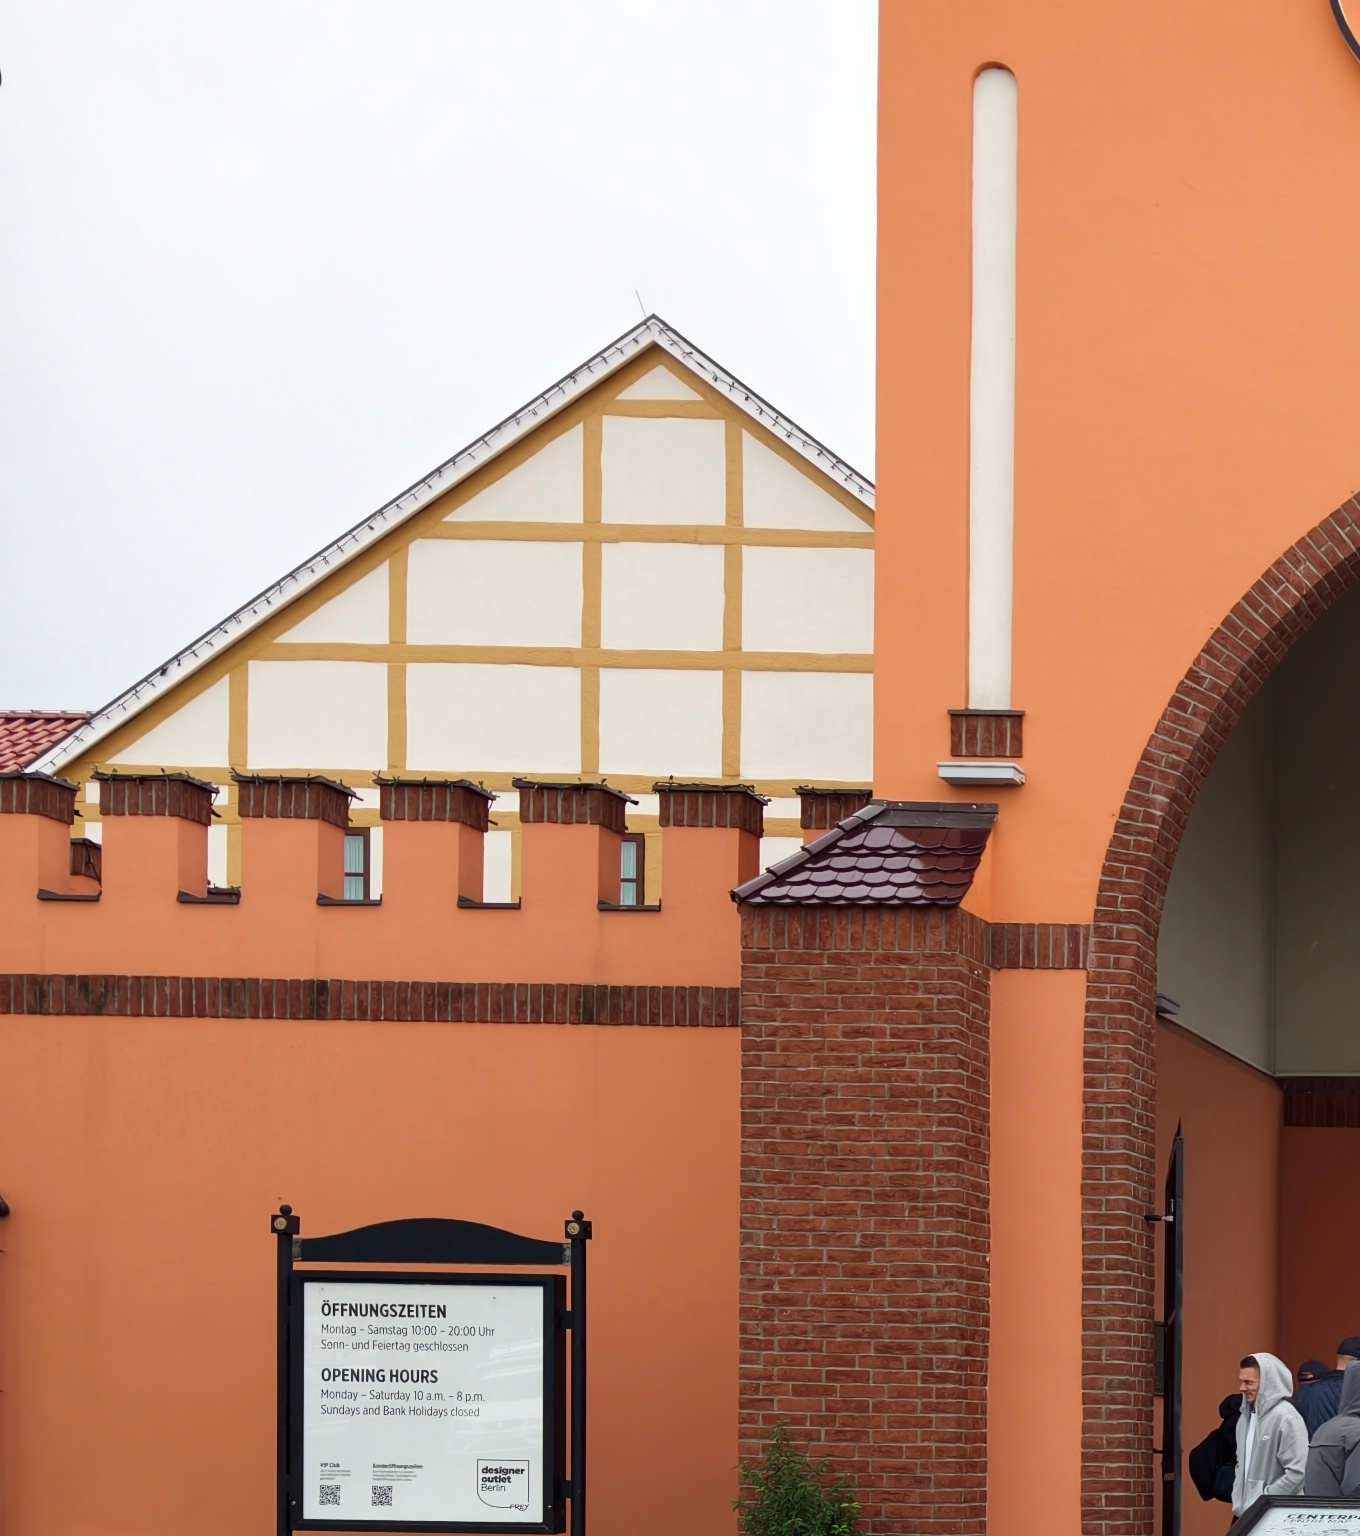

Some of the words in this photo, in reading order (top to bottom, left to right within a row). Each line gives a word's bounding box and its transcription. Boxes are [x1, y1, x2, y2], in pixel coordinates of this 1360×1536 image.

[321, 1300, 446, 1318] ÖFFNUNGSZEITEN
[321, 1324, 356, 1336] Montag
[368, 1325, 408, 1336] Samstag
[412, 1325, 437, 1336] 10:00
[448, 1326, 475, 1337] 20:00
[479, 1327, 495, 1337] Uhr
[321, 1339, 349, 1350] Sonn-
[352, 1339, 369, 1350] und
[373, 1340, 410, 1352] Feiertag
[413, 1341, 469, 1352] geschlossen
[321, 1368, 385, 1382] OPENING
[389, 1369, 438, 1383] HOURS
[321, 1390, 358, 1401] Monday
[369, 1390, 410, 1402] Saturday
[414, 1391, 423, 1401] 10
[426, 1393, 445, 1401] a.m.
[457, 1392, 463, 1401] 8
[465, 1393, 485, 1402] p.m.
[321, 1405, 360, 1416] Sundays
[363, 1406, 380, 1416] and
[384, 1406, 406, 1416] Bank
[409, 1406, 448, 1418] Holidays
[450, 1407, 480, 1417] closed
[482, 1466, 525, 1475] designer
[482, 1475, 511, 1483] outlet
[481, 1484, 505, 1492] Berlin
